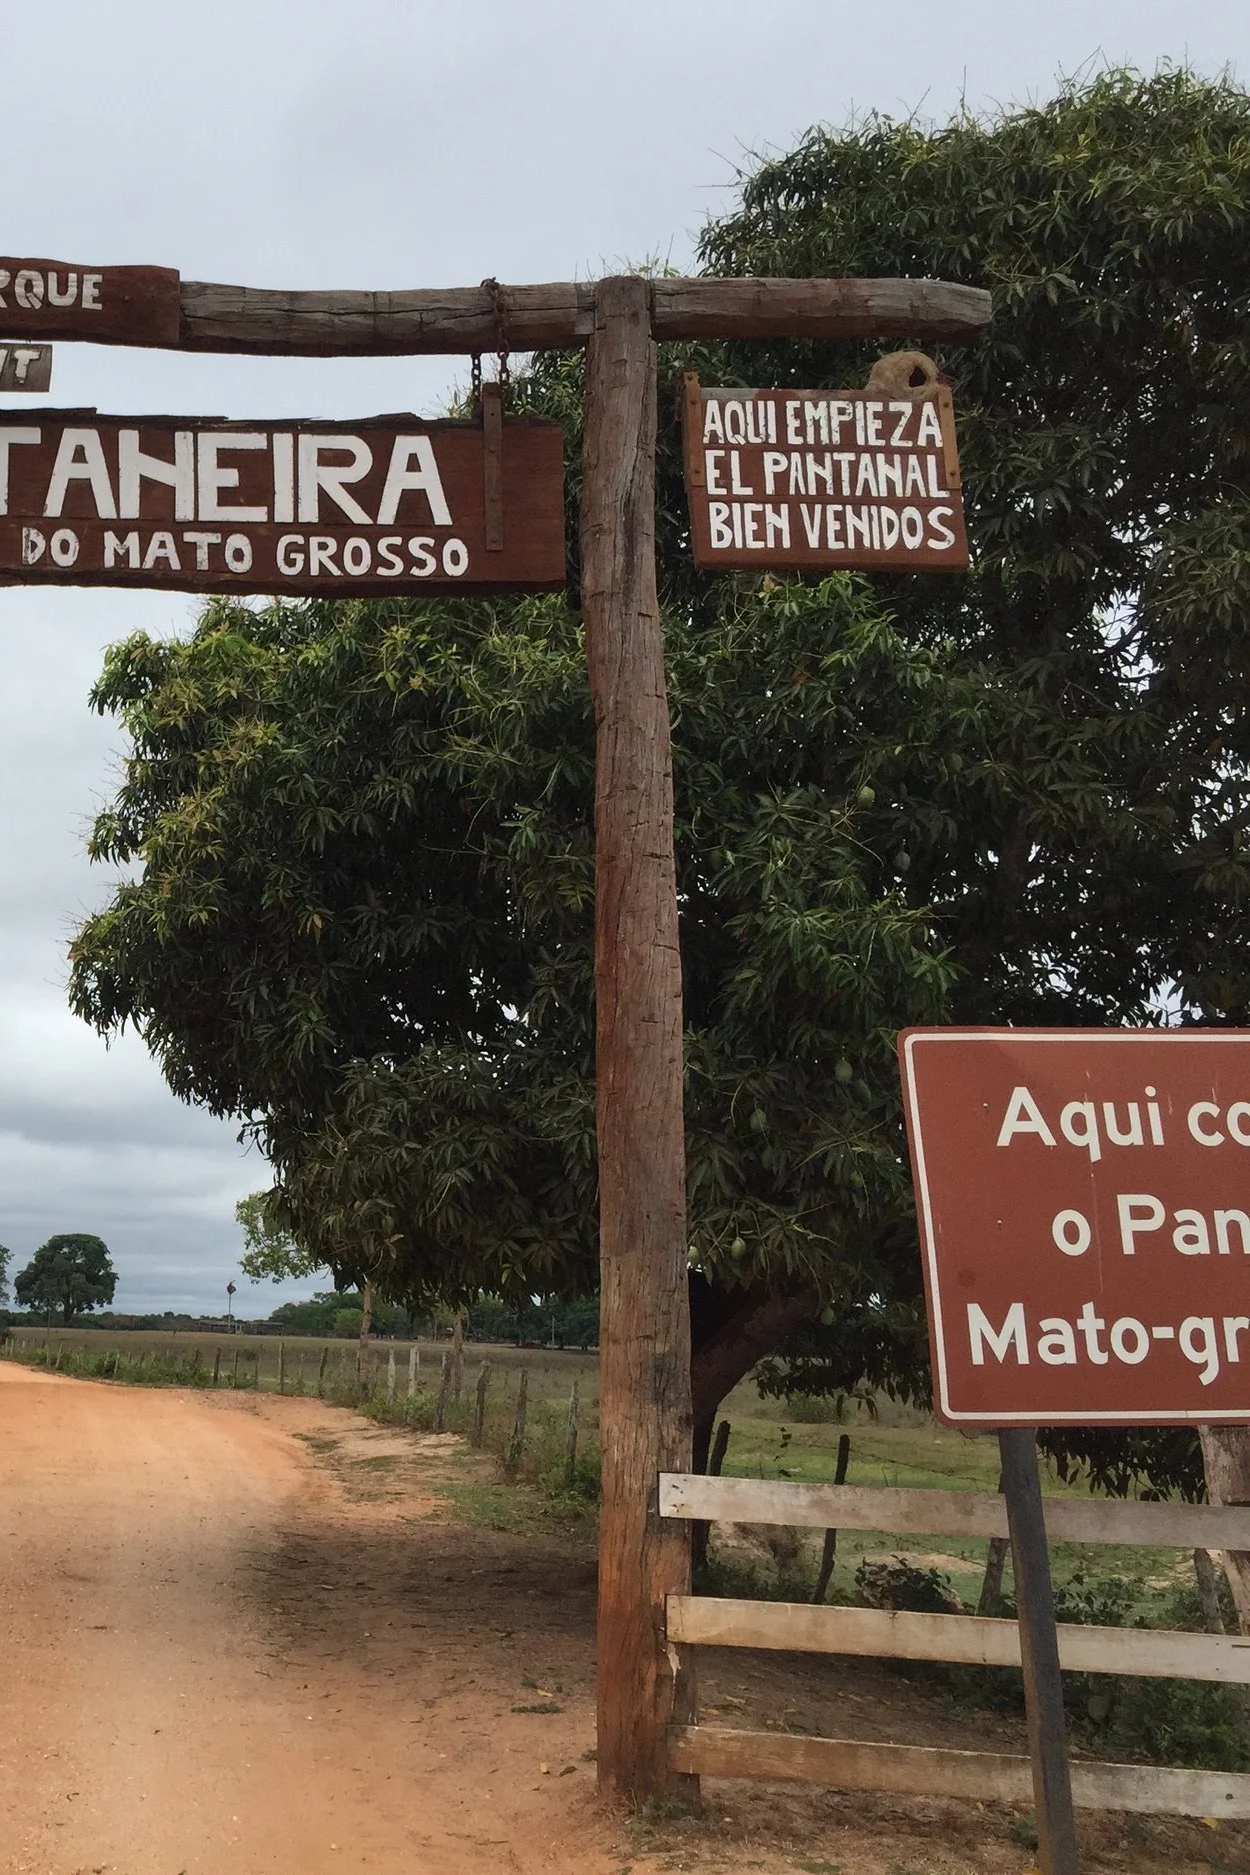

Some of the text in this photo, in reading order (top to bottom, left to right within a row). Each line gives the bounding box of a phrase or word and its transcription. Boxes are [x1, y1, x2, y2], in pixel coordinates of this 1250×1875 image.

[702, 399, 943, 448] AQUI EMPIEZA
[705, 449, 950, 498] EL PANTANAL
[22, 527, 80, 567] DO
[103, 530, 253, 573] MATO
[276, 534, 469, 577] GROSSO
[996, 1085, 1165, 1163] Aqui
[1052, 1193, 1250, 1256] o Pan
[966, 1301, 1250, 1387] Mato-gr
